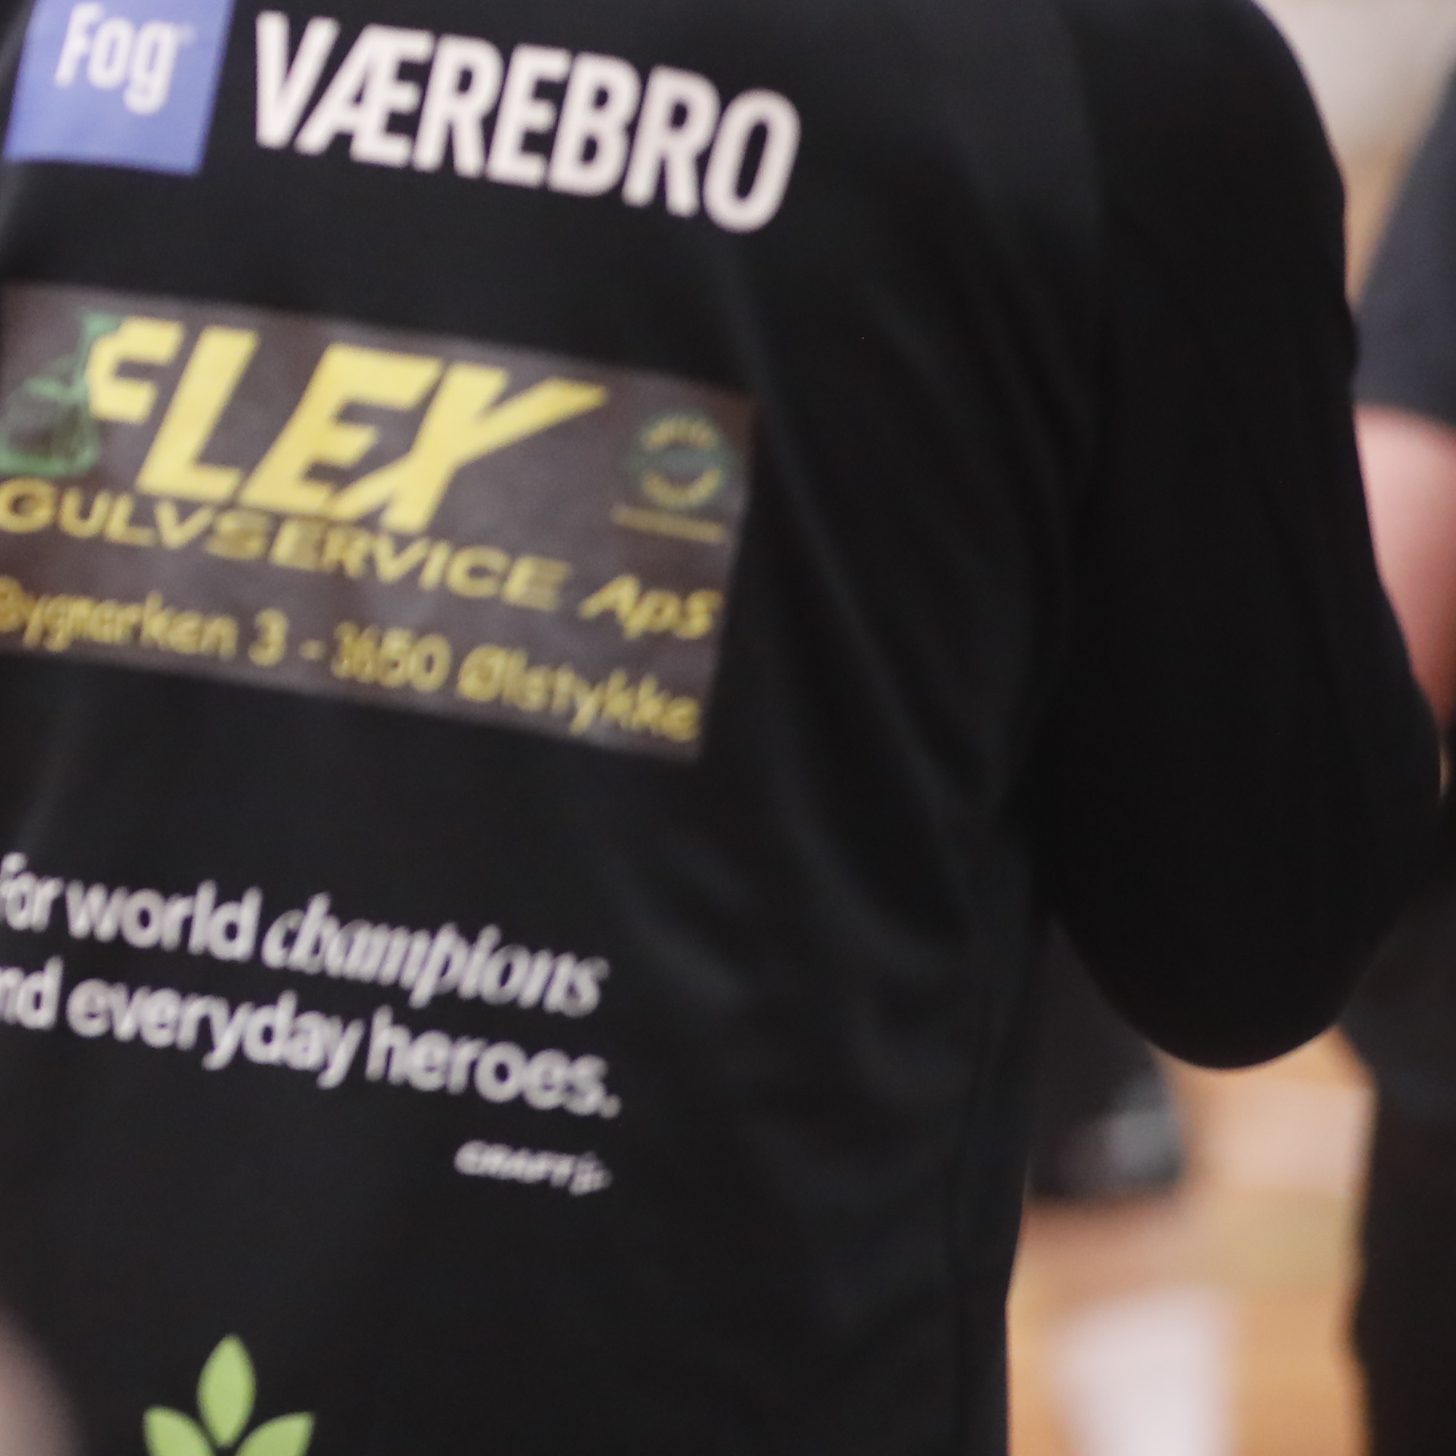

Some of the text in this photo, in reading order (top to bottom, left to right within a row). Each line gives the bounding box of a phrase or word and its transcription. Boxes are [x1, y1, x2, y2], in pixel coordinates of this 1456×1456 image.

[53, 1, 181, 117] Fog
[255, 10, 801, 233] VÆREBRO
[84, 315, 607, 534] FLEX
[248, 607, 288, 667] 3
[456, 643, 701, 741] Ølstykke
[577, 573, 725, 640] Aps
[65, 879, 263, 963] world
[261, 891, 610, 1017] champions
[66, 977, 364, 1089] everyday
[364, 1004, 622, 1119] heroes.
